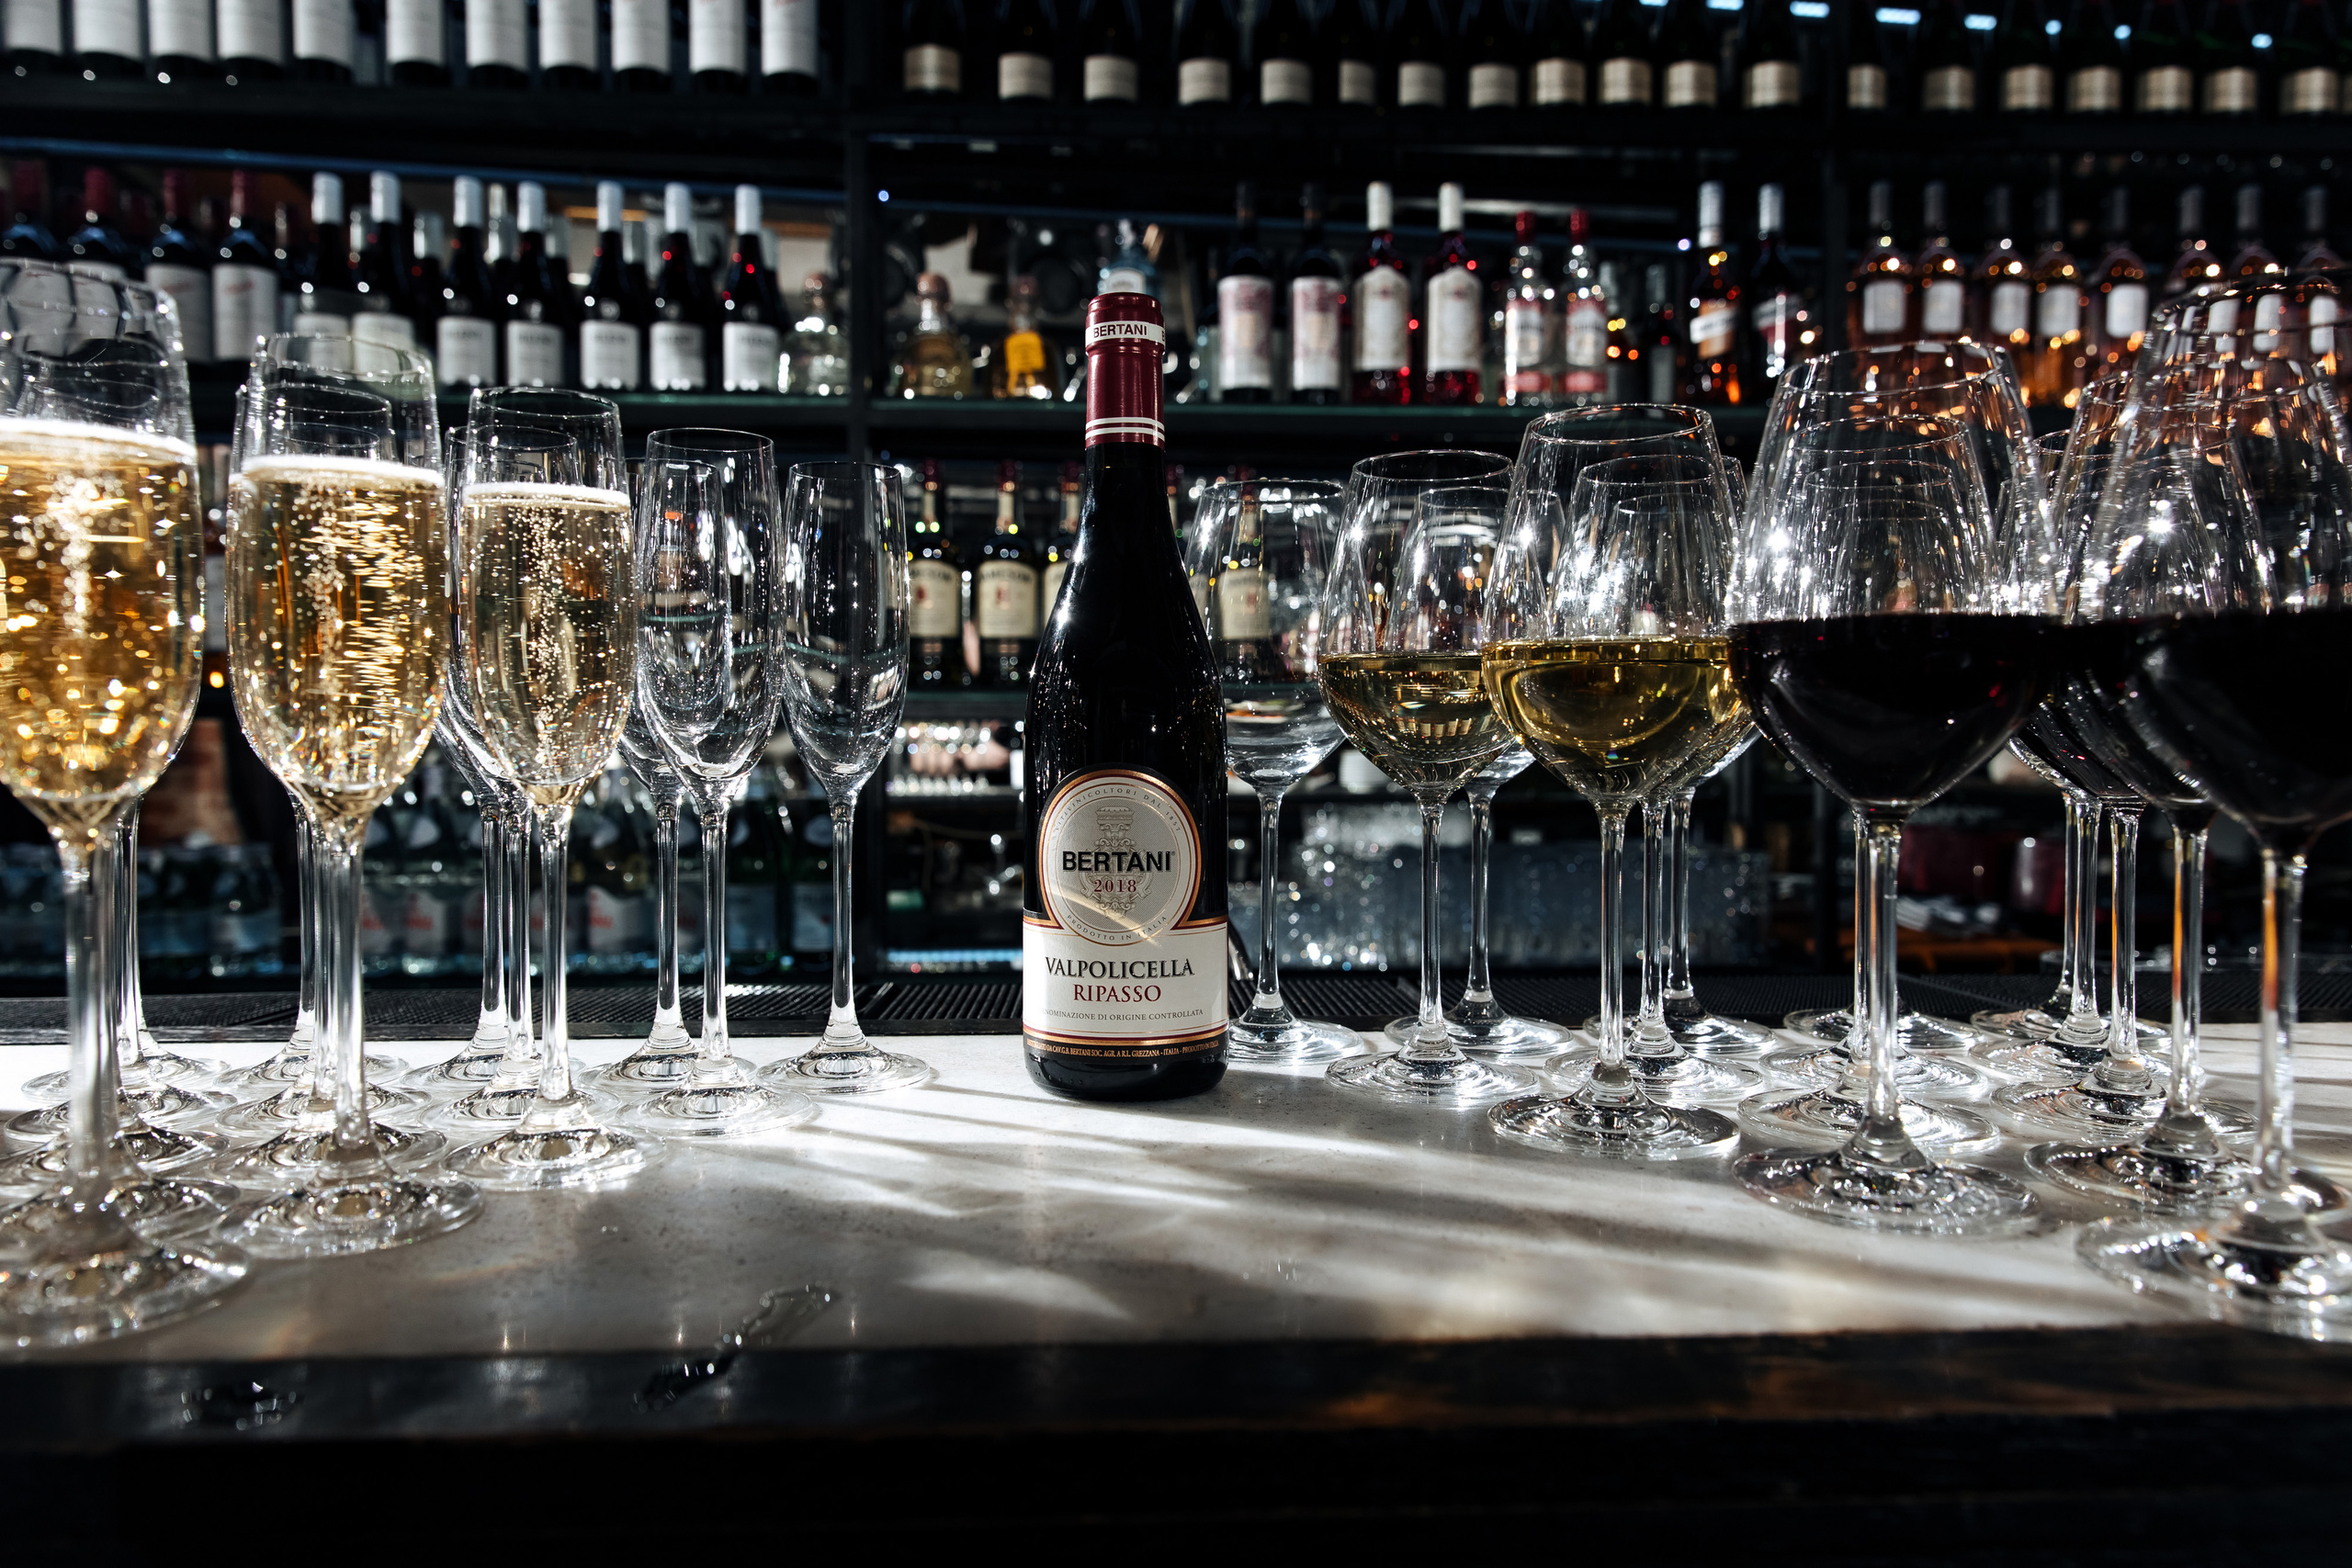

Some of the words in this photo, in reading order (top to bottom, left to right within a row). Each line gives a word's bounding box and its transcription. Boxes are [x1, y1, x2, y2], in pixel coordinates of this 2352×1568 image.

[1093, 323, 1148, 339] BERTANI
[1055, 787, 1137, 831] VITIVINICOLTORI
[1143, 794, 1161, 809] DAL
[1165, 811, 1182, 831] 1857
[1062, 851, 1171, 873] BERTANI
[1093, 879, 1137, 893] 2018
[1067, 915, 1115, 942] PRODOTTO
[1137, 915, 1168, 938] ITALIA
[1045, 956, 1195, 980] VALPOLICELLA
[1073, 984, 1162, 1003] RIPASSO
[1148, 1009, 1204, 1021] CONTROLLATA
[1070, 1047, 1091, 1056] BERTANI
[1132, 1049, 1159, 1057] GREZZANA
[1163, 1047, 1180, 1056] ITALIA
[1182, 1043, 1204, 1054] PRODOTTO
